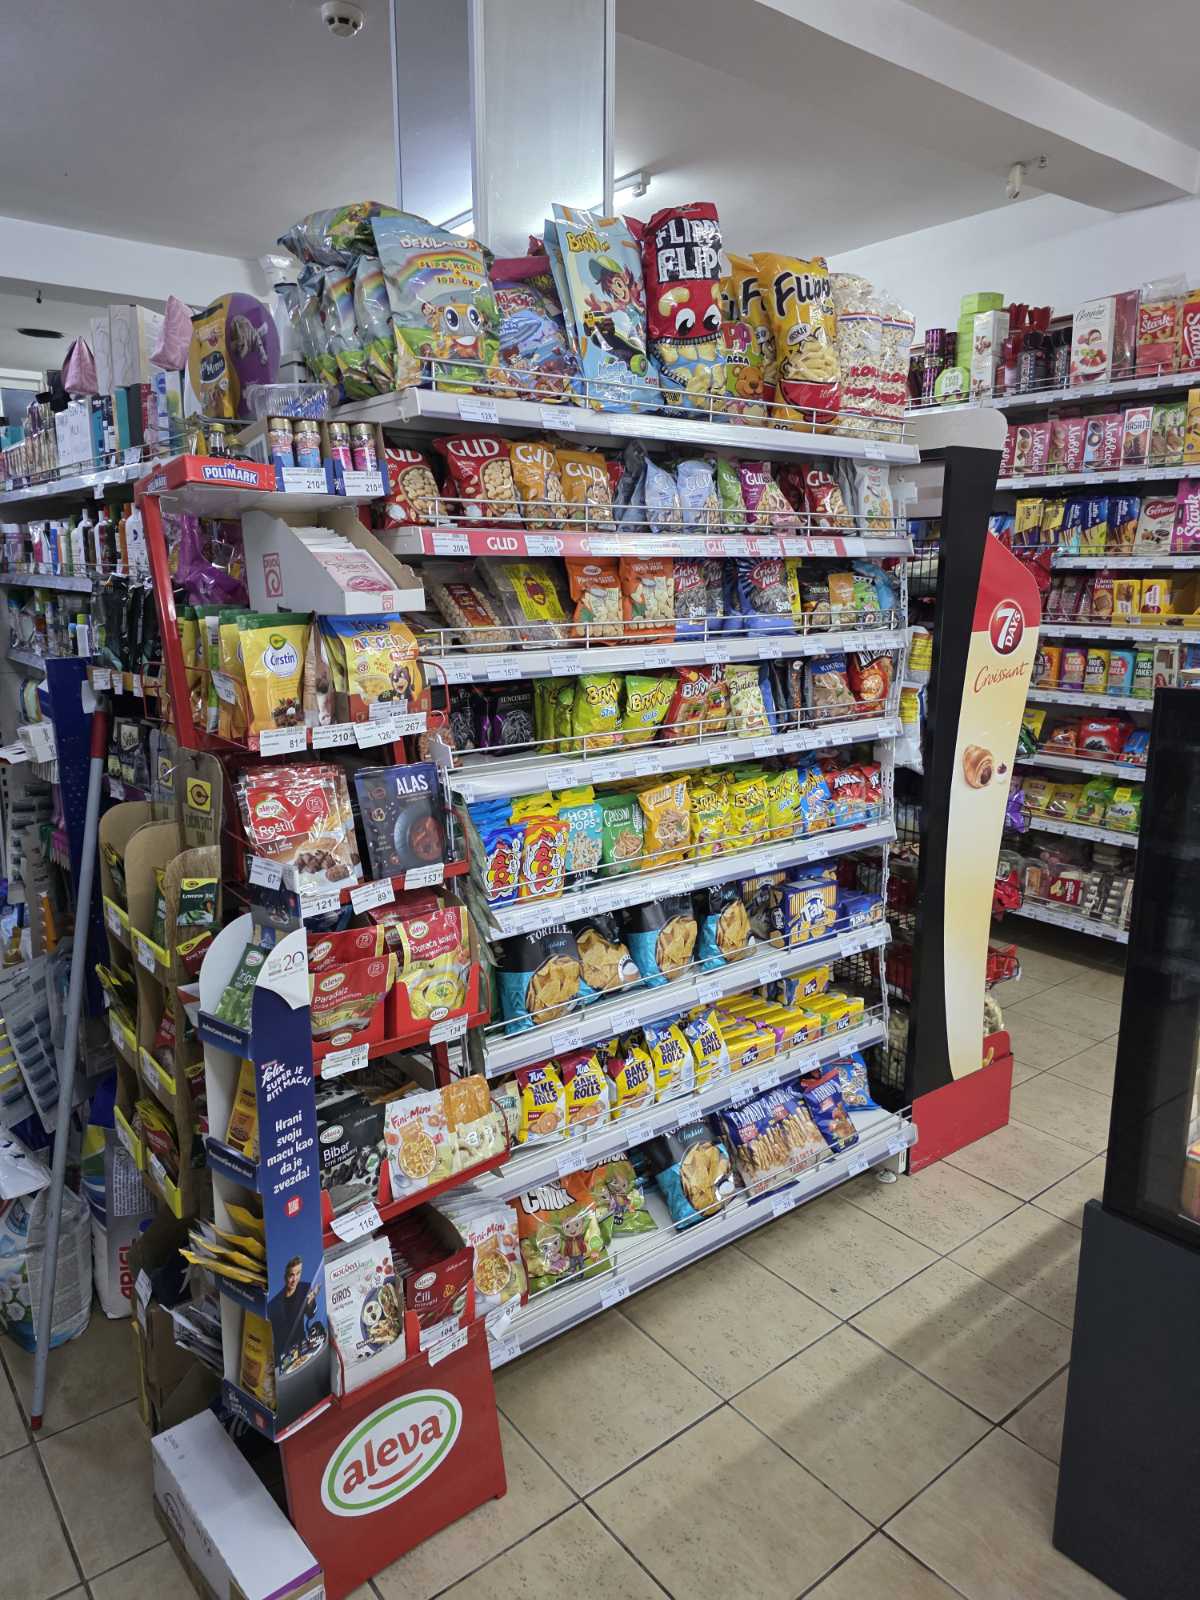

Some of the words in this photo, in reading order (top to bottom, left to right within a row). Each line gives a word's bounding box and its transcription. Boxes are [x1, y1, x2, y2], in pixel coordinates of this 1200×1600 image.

[446, 438, 500, 458] GUD
[202, 463, 258, 485] POLIMARK
[306, 480, 320, 490] 210
[365, 483, 379, 493] 210
[486, 536, 518, 551] GUD
[997, 607, 1017, 649] 7
[1004, 609, 1022, 648] DAYS
[973, 661, 1030, 695] Croissant
[404, 721, 420, 732] 267
[332, 733, 349, 743] 210
[395, 774, 429, 796] ALAS
[568, 819, 597, 833] POPS
[315, 899, 333, 911] 121
[321, 975, 346, 989] aleva
[314, 988, 350, 1005] Paradajz
[332, 1034, 352, 1045] aleva
[658, 1040, 682, 1057] BAKE
[661, 1048, 685, 1066] ROLLS
[266, 1069, 292, 1093] SUPER
[294, 1065, 304, 1076] JE
[527, 1069, 547, 1084] TUC
[624, 1062, 648, 1080] BAKE
[266, 1087, 282, 1103] BITI
[283, 1076, 312, 1090] MACA!
[626, 1070, 650, 1091] ROLLS
[573, 1084, 602, 1101] ROLLS
[275, 1110, 303, 1133] Hrani
[276, 1127, 303, 1148] svoju
[267, 1147, 294, 1168] macu
[295, 1137, 314, 1153] kao
[323, 1141, 350, 1163] Biber
[279, 1162, 292, 1176] da
[292, 1157, 303, 1172] je
[273, 1165, 311, 1195] zvezda!
[359, 1217, 374, 1231] 116
[331, 1287, 352, 1305] GIROS
[342, 1413, 445, 1495] aleva
